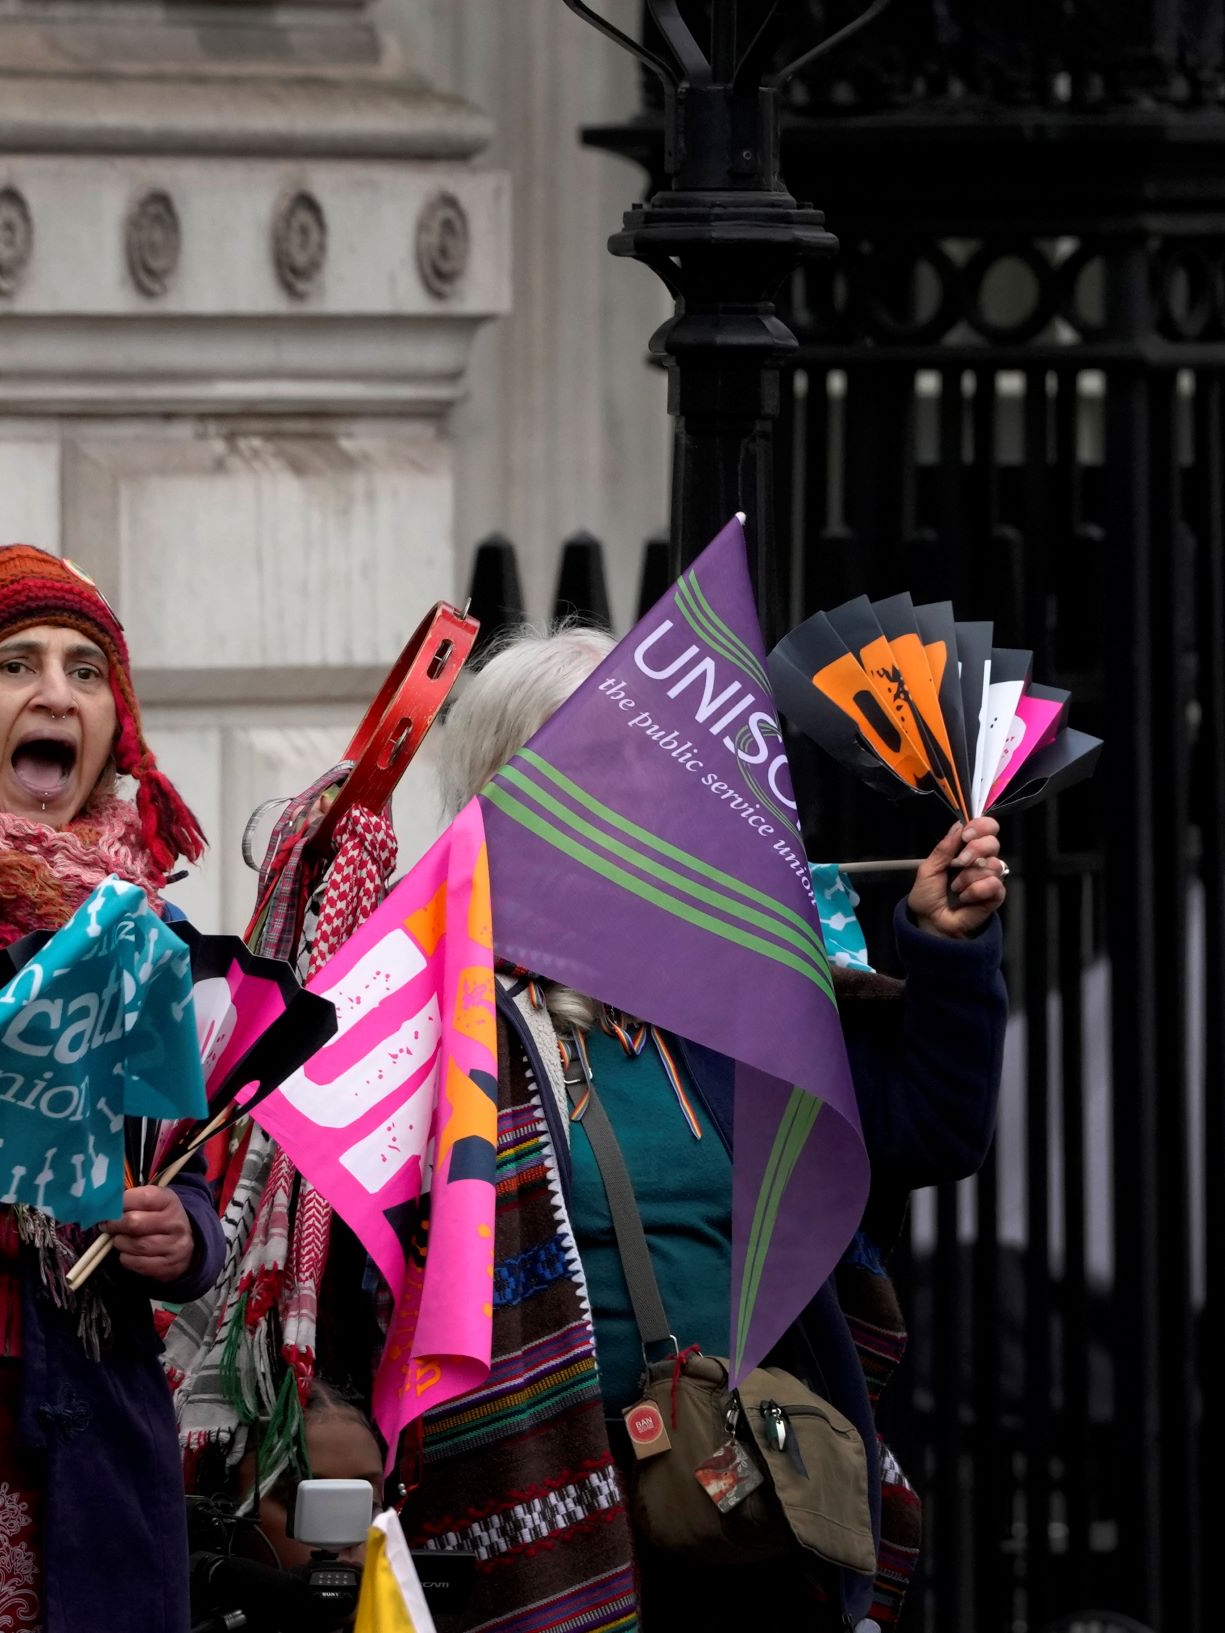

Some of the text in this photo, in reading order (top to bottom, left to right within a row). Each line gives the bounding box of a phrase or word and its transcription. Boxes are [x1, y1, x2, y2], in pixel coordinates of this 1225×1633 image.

[598, 677, 636, 711] the
[628, 711, 704, 773] public
[701, 773, 775, 837] service
[634, 619, 802, 832] UNISO
